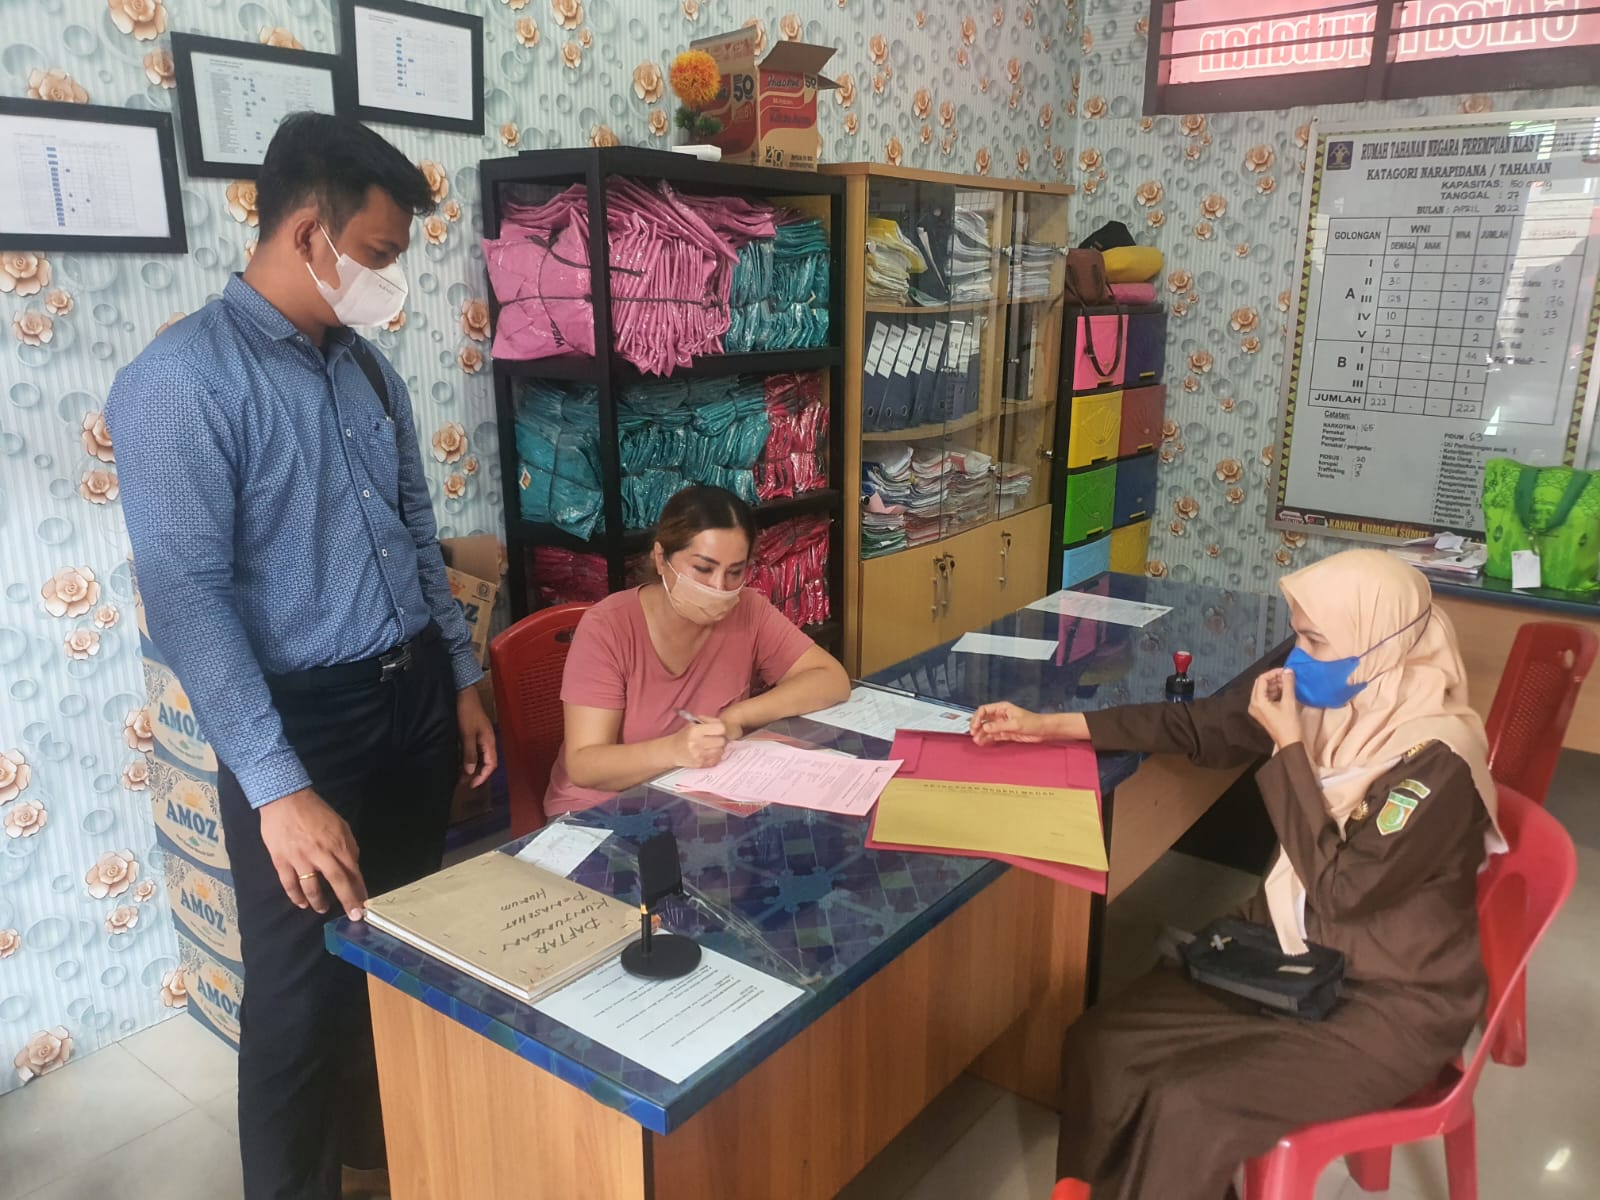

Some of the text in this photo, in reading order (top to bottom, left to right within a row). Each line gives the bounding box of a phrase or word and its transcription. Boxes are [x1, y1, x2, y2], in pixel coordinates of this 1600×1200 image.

[1361, 142, 1388, 160] RUMAH
[1390, 140, 1427, 159] TAHANAN
[1427, 139, 1459, 157] NEGARA
[1461, 136, 1511, 156] PEREMPUAN
[1367, 167, 1418, 180] KATAGORI
[1420, 165, 1486, 179] NARAPIDANA
[1500, 162, 1552, 176] TAHANAN
[1441, 191, 1490, 200] TANGGAL
[1410, 225, 1431, 234] WNI
[1334, 231, 1381, 240] GOLONGAN
[1390, 242, 1416, 250] DEWASA
[1364, 277, 1373, 285] II
[1345, 287, 1355, 300] A
[1360, 295, 1372, 303] III
[1357, 313, 1371, 321] IV
[1357, 330, 1367, 338] V
[1337, 356, 1347, 368] B
[1356, 363, 1364, 371] II
[1352, 379, 1364, 388] III
[1314, 393, 1362, 404] JUMLAH
[1328, 518, 1360, 532] KANWIL
[1361, 522, 1398, 537] KUMHAM
[166, 799, 219, 843] AMOZ
[180, 887, 227, 937] AMOZ
[501, 897, 610, 953] KUNJUNGAN
[535, 916, 601, 955] DAFTAR
